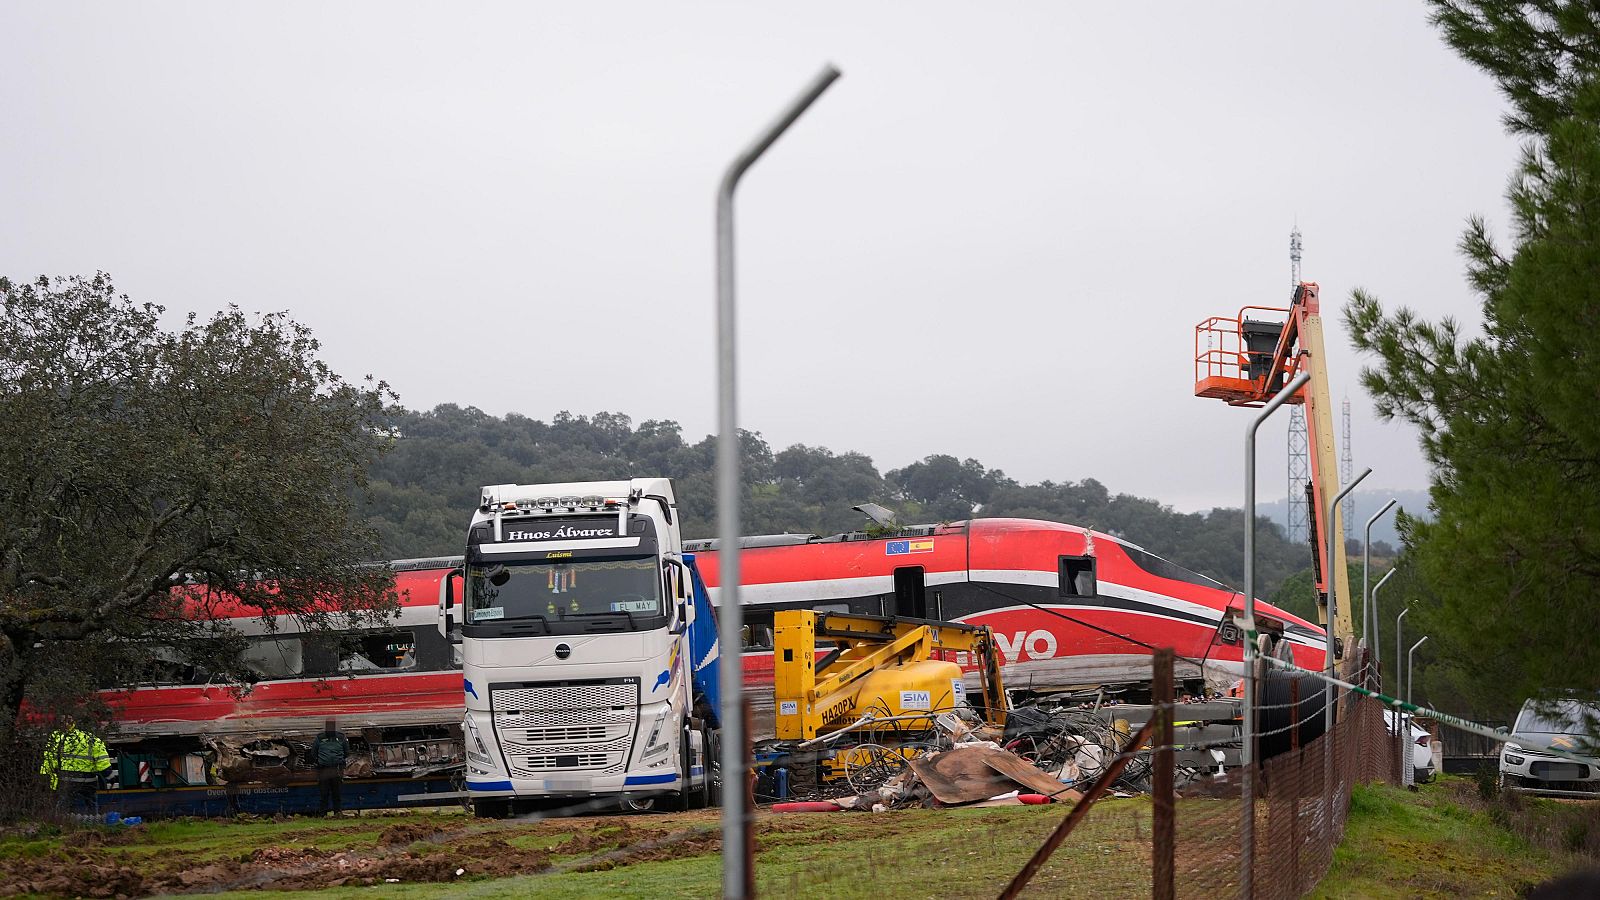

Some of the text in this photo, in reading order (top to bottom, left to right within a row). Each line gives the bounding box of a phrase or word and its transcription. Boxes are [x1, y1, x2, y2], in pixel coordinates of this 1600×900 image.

[508, 525, 614, 540] Hnos Álvarez
[545, 550, 573, 559] Luismi
[619, 602, 630, 611] EL
[903, 693, 929, 702] SIM
[821, 695, 857, 725] HA20PX
